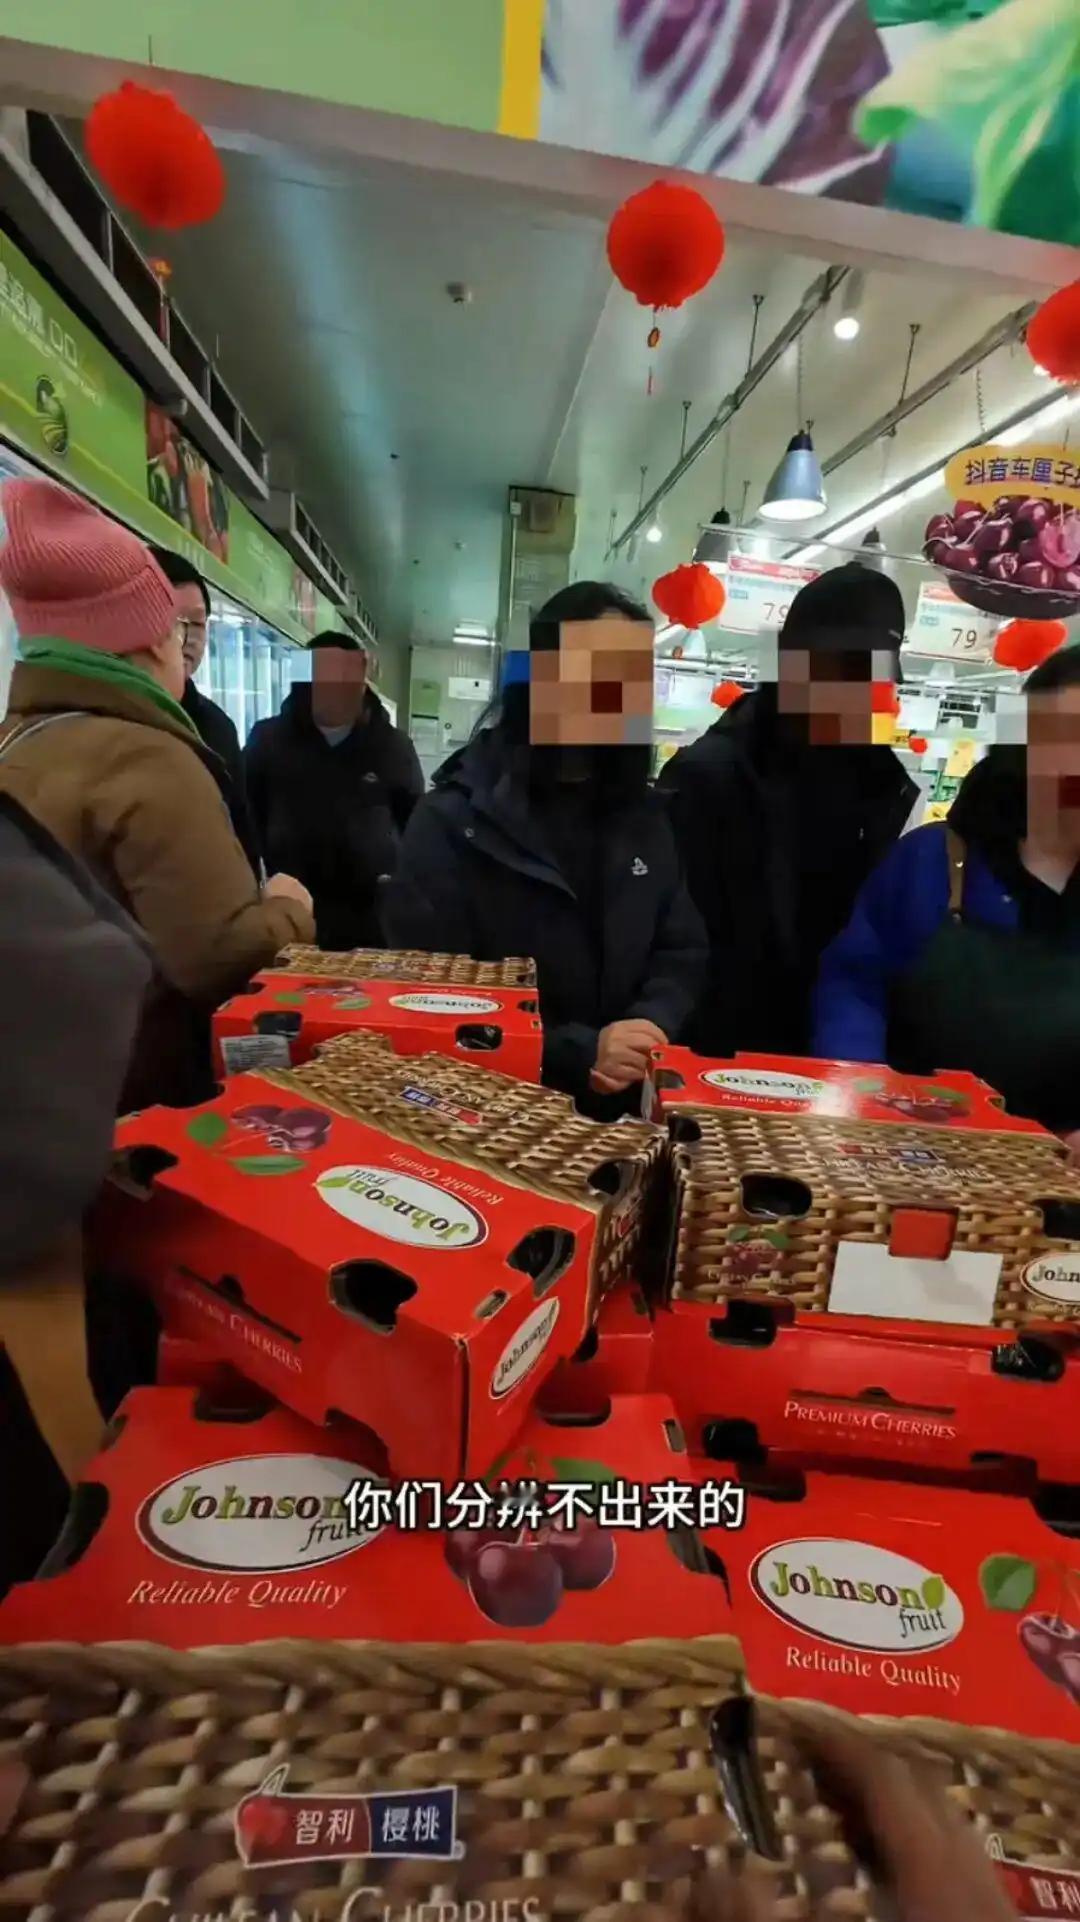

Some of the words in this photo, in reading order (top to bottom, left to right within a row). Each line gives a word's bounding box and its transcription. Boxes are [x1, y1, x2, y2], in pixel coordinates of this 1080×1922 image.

[952, 628, 977, 648] 79
[349, 1180, 470, 1241] Johnson
[784, 1400, 868, 1428] PREMIUM
[870, 1412, 956, 1440] CHERRIES
[127, 1579, 240, 1604] Reliable
[248, 1579, 348, 1609] Quality
[770, 1561, 925, 1611] Johnson
[898, 1608, 947, 1638] fruit
[786, 1645, 872, 1678] Reliable
[879, 1659, 961, 1696] Quality
[295, 1808, 356, 1846] 智利
